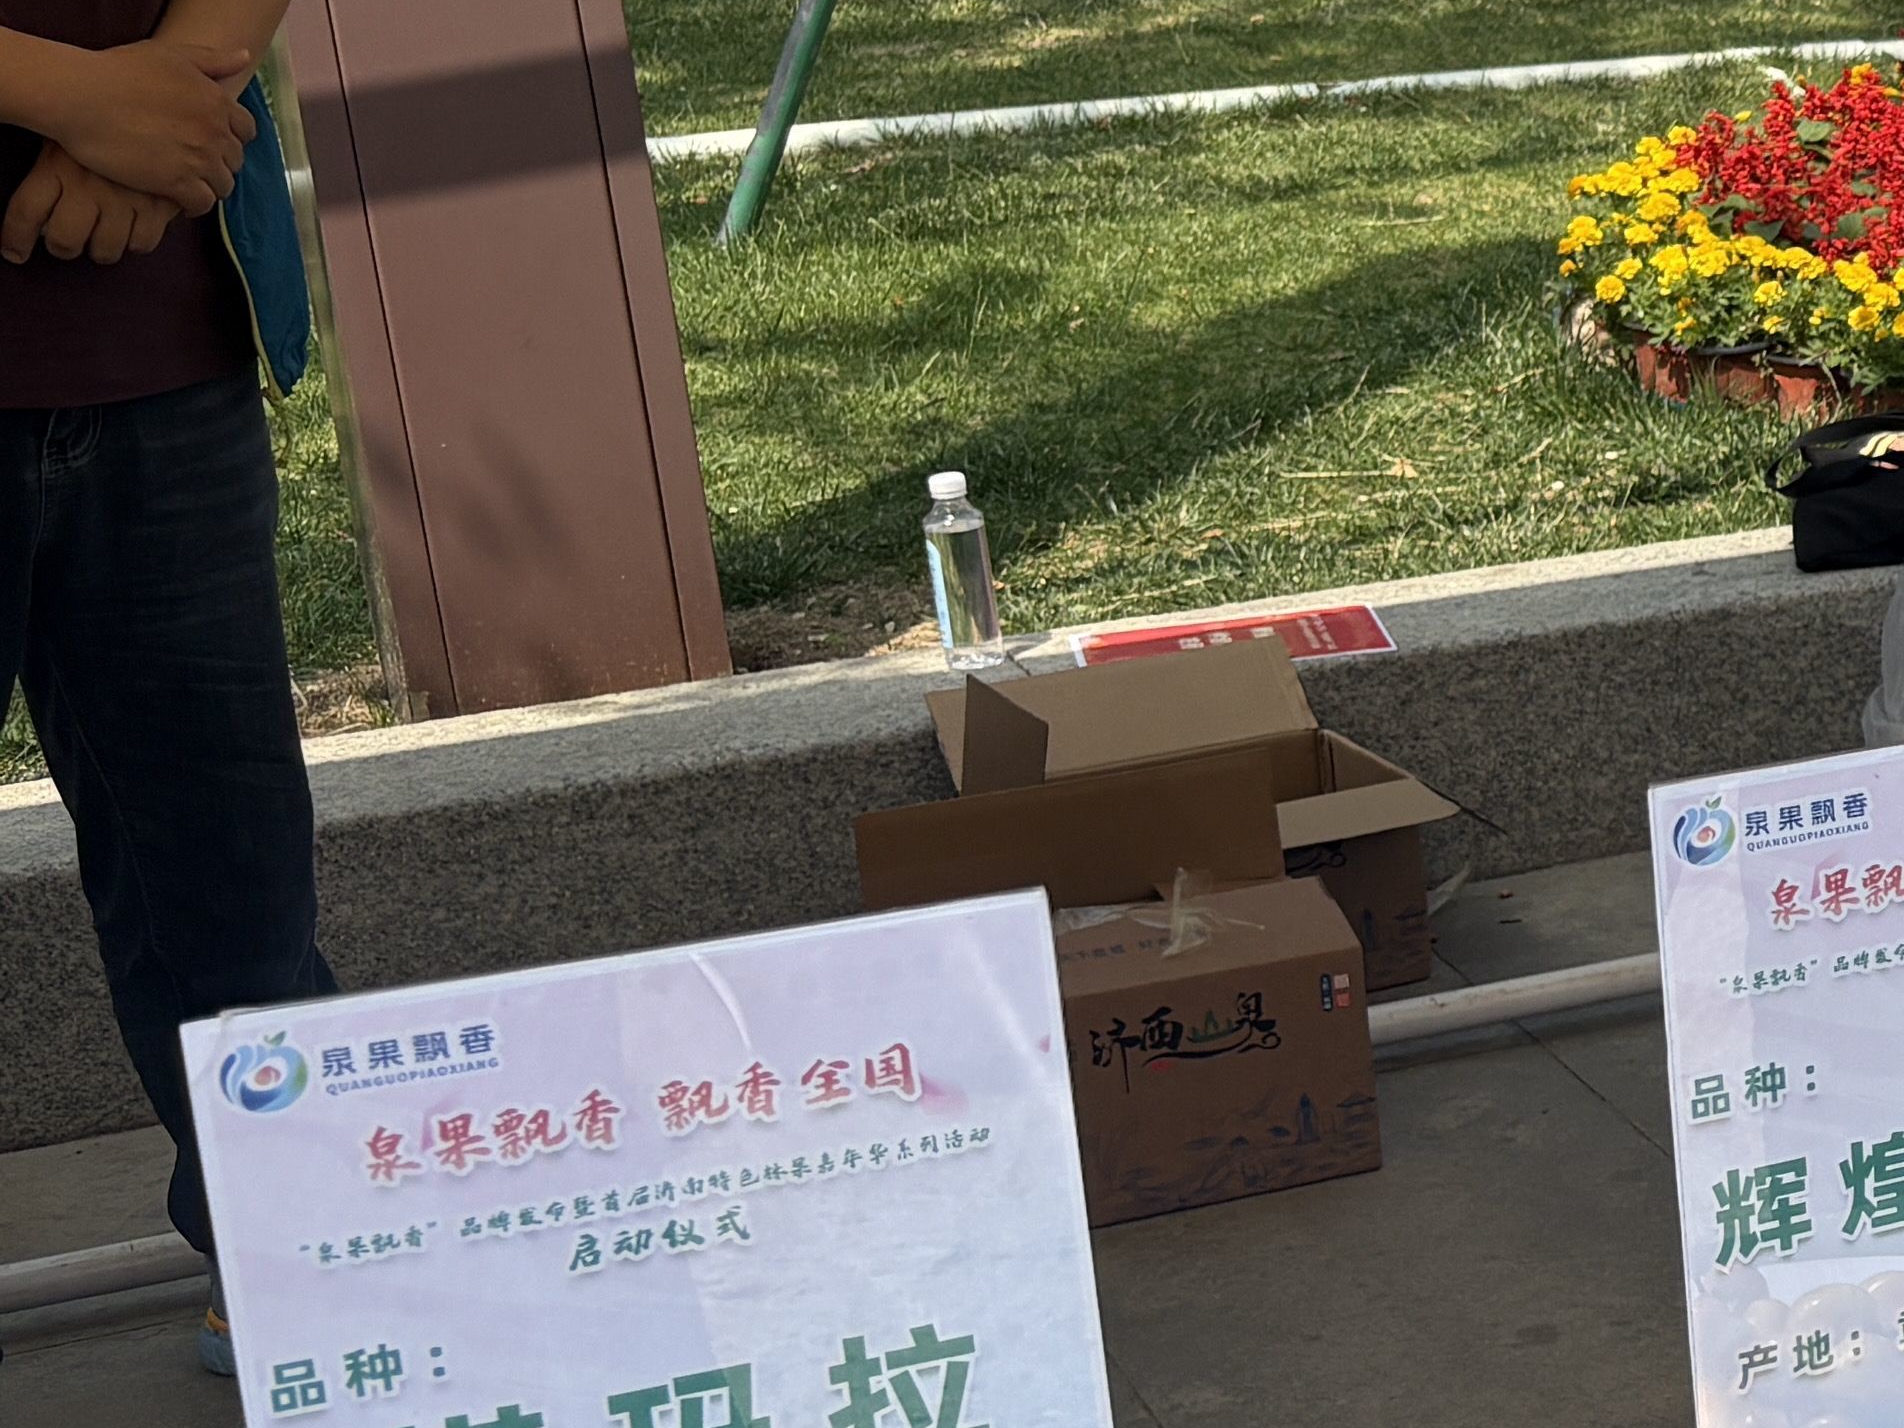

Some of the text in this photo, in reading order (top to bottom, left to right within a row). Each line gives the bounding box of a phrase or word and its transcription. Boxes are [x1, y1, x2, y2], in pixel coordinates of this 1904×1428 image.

[1744, 793, 1868, 837] 泉果飘香
[1747, 821, 1869, 851] QUANGUOPIAOXIANG
[1719, 960, 1818, 994] “泉果飘香”
[321, 1024, 495, 1078] 泉果飘香
[326, 1057, 499, 1096] QUANGUOPIAOXIANG
[1688, 1063, 1819, 1121] 品种：
[365, 1042, 917, 1181] 泉果飘香 飘香全国
[299, 1221, 438, 1263] “泉果飘香”
[569, 1205, 751, 1272] 启动仪式
[269, 1341, 449, 1414] 品种：
